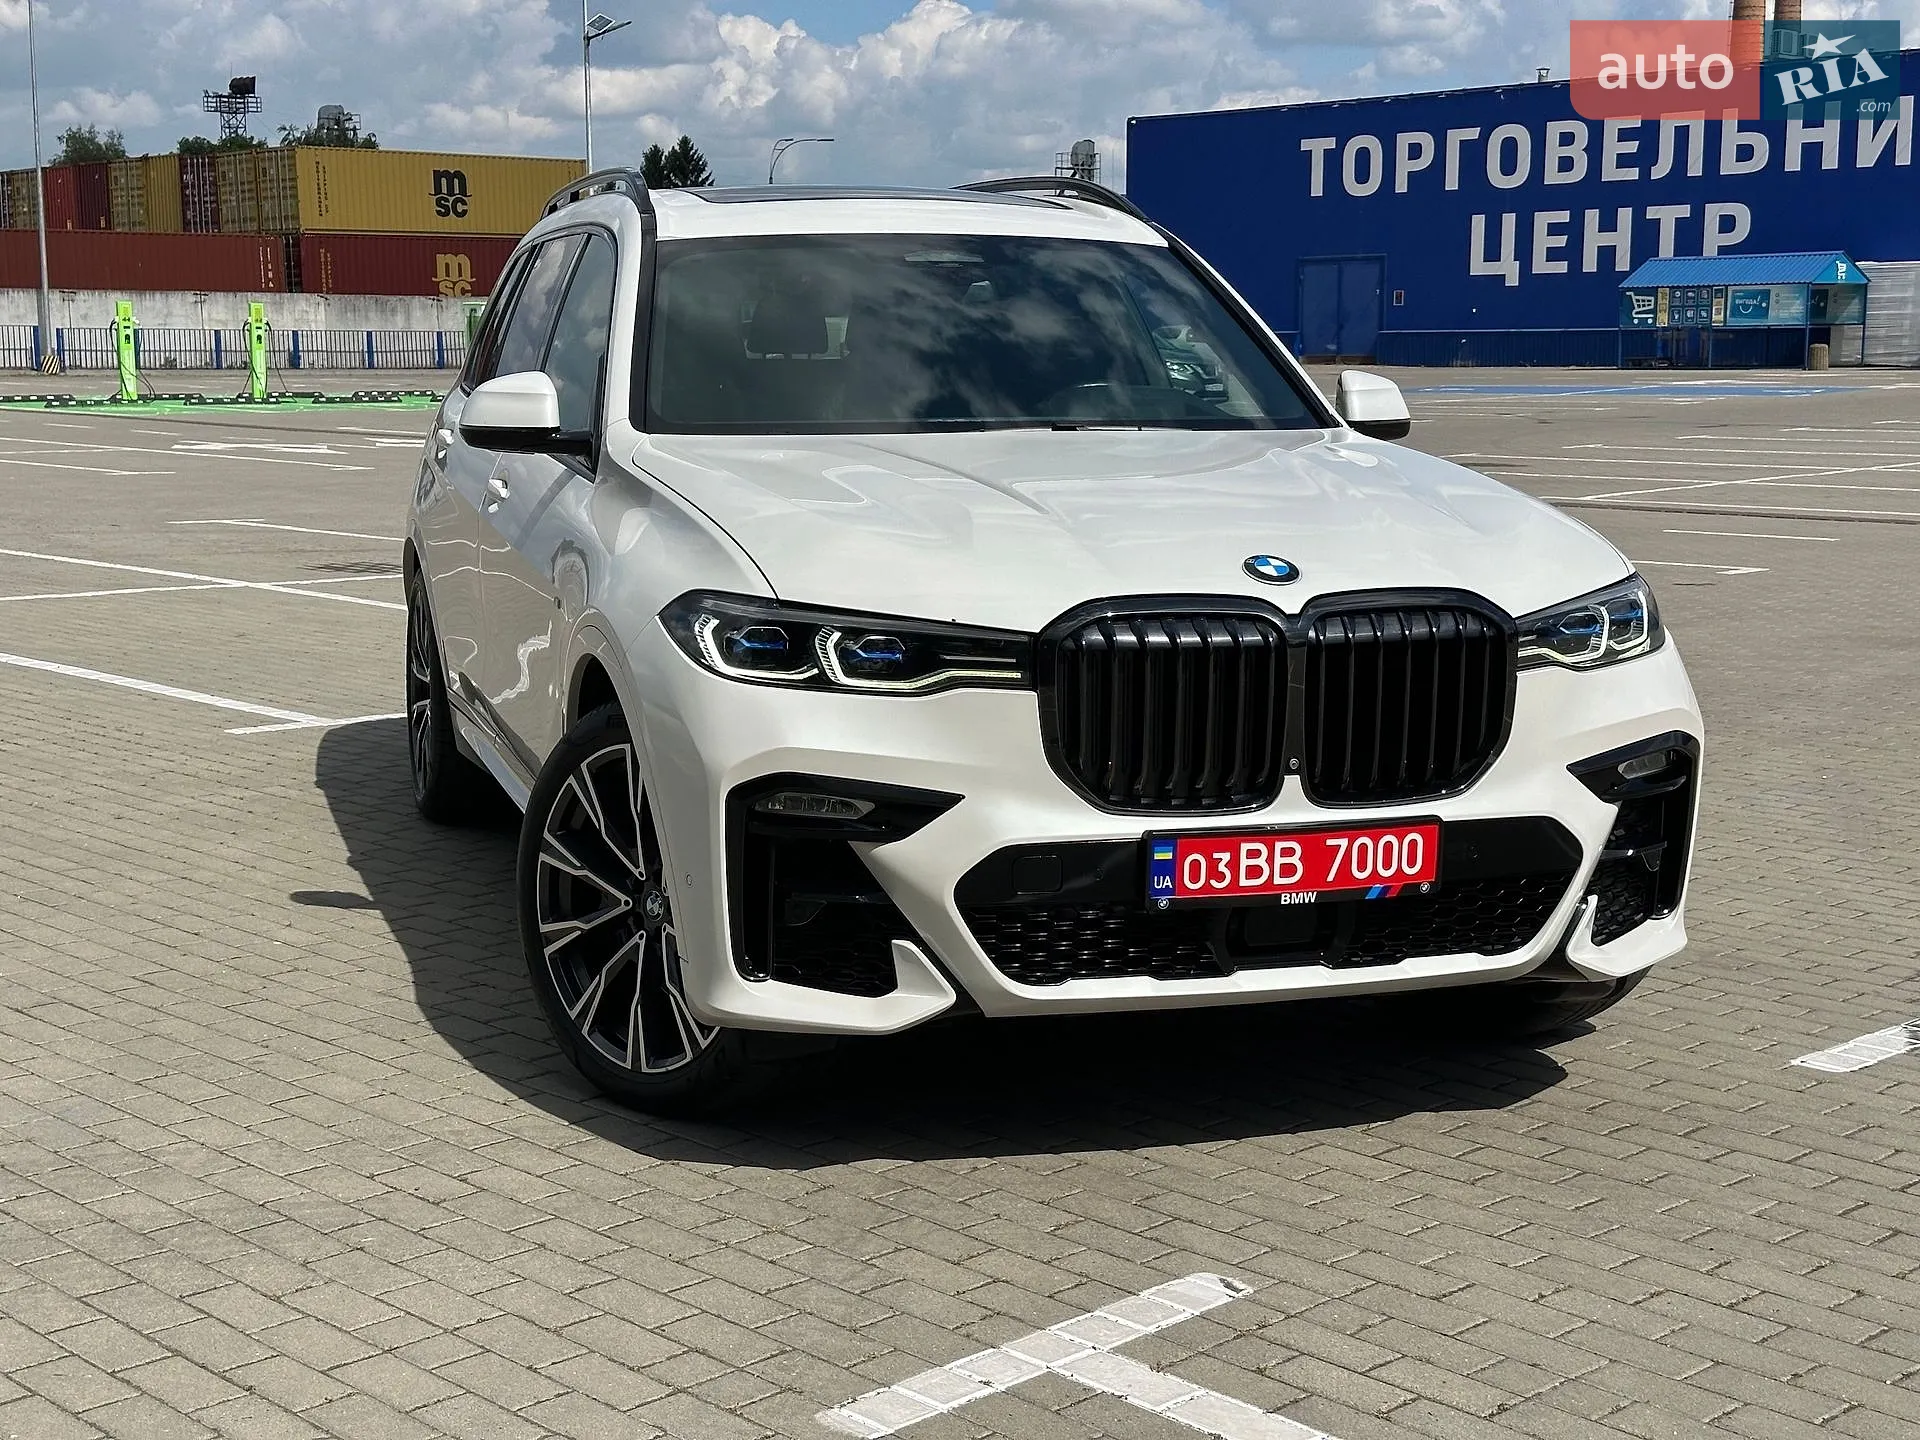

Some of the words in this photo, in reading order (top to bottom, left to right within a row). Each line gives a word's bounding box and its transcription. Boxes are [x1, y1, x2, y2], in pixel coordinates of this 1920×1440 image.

[1470, 202, 1753, 287] ЦЕНТР
[1325, 832, 1425, 882] 7000
[1153, 875, 1173, 890] UA
[1280, 891, 1317, 905] BMW
